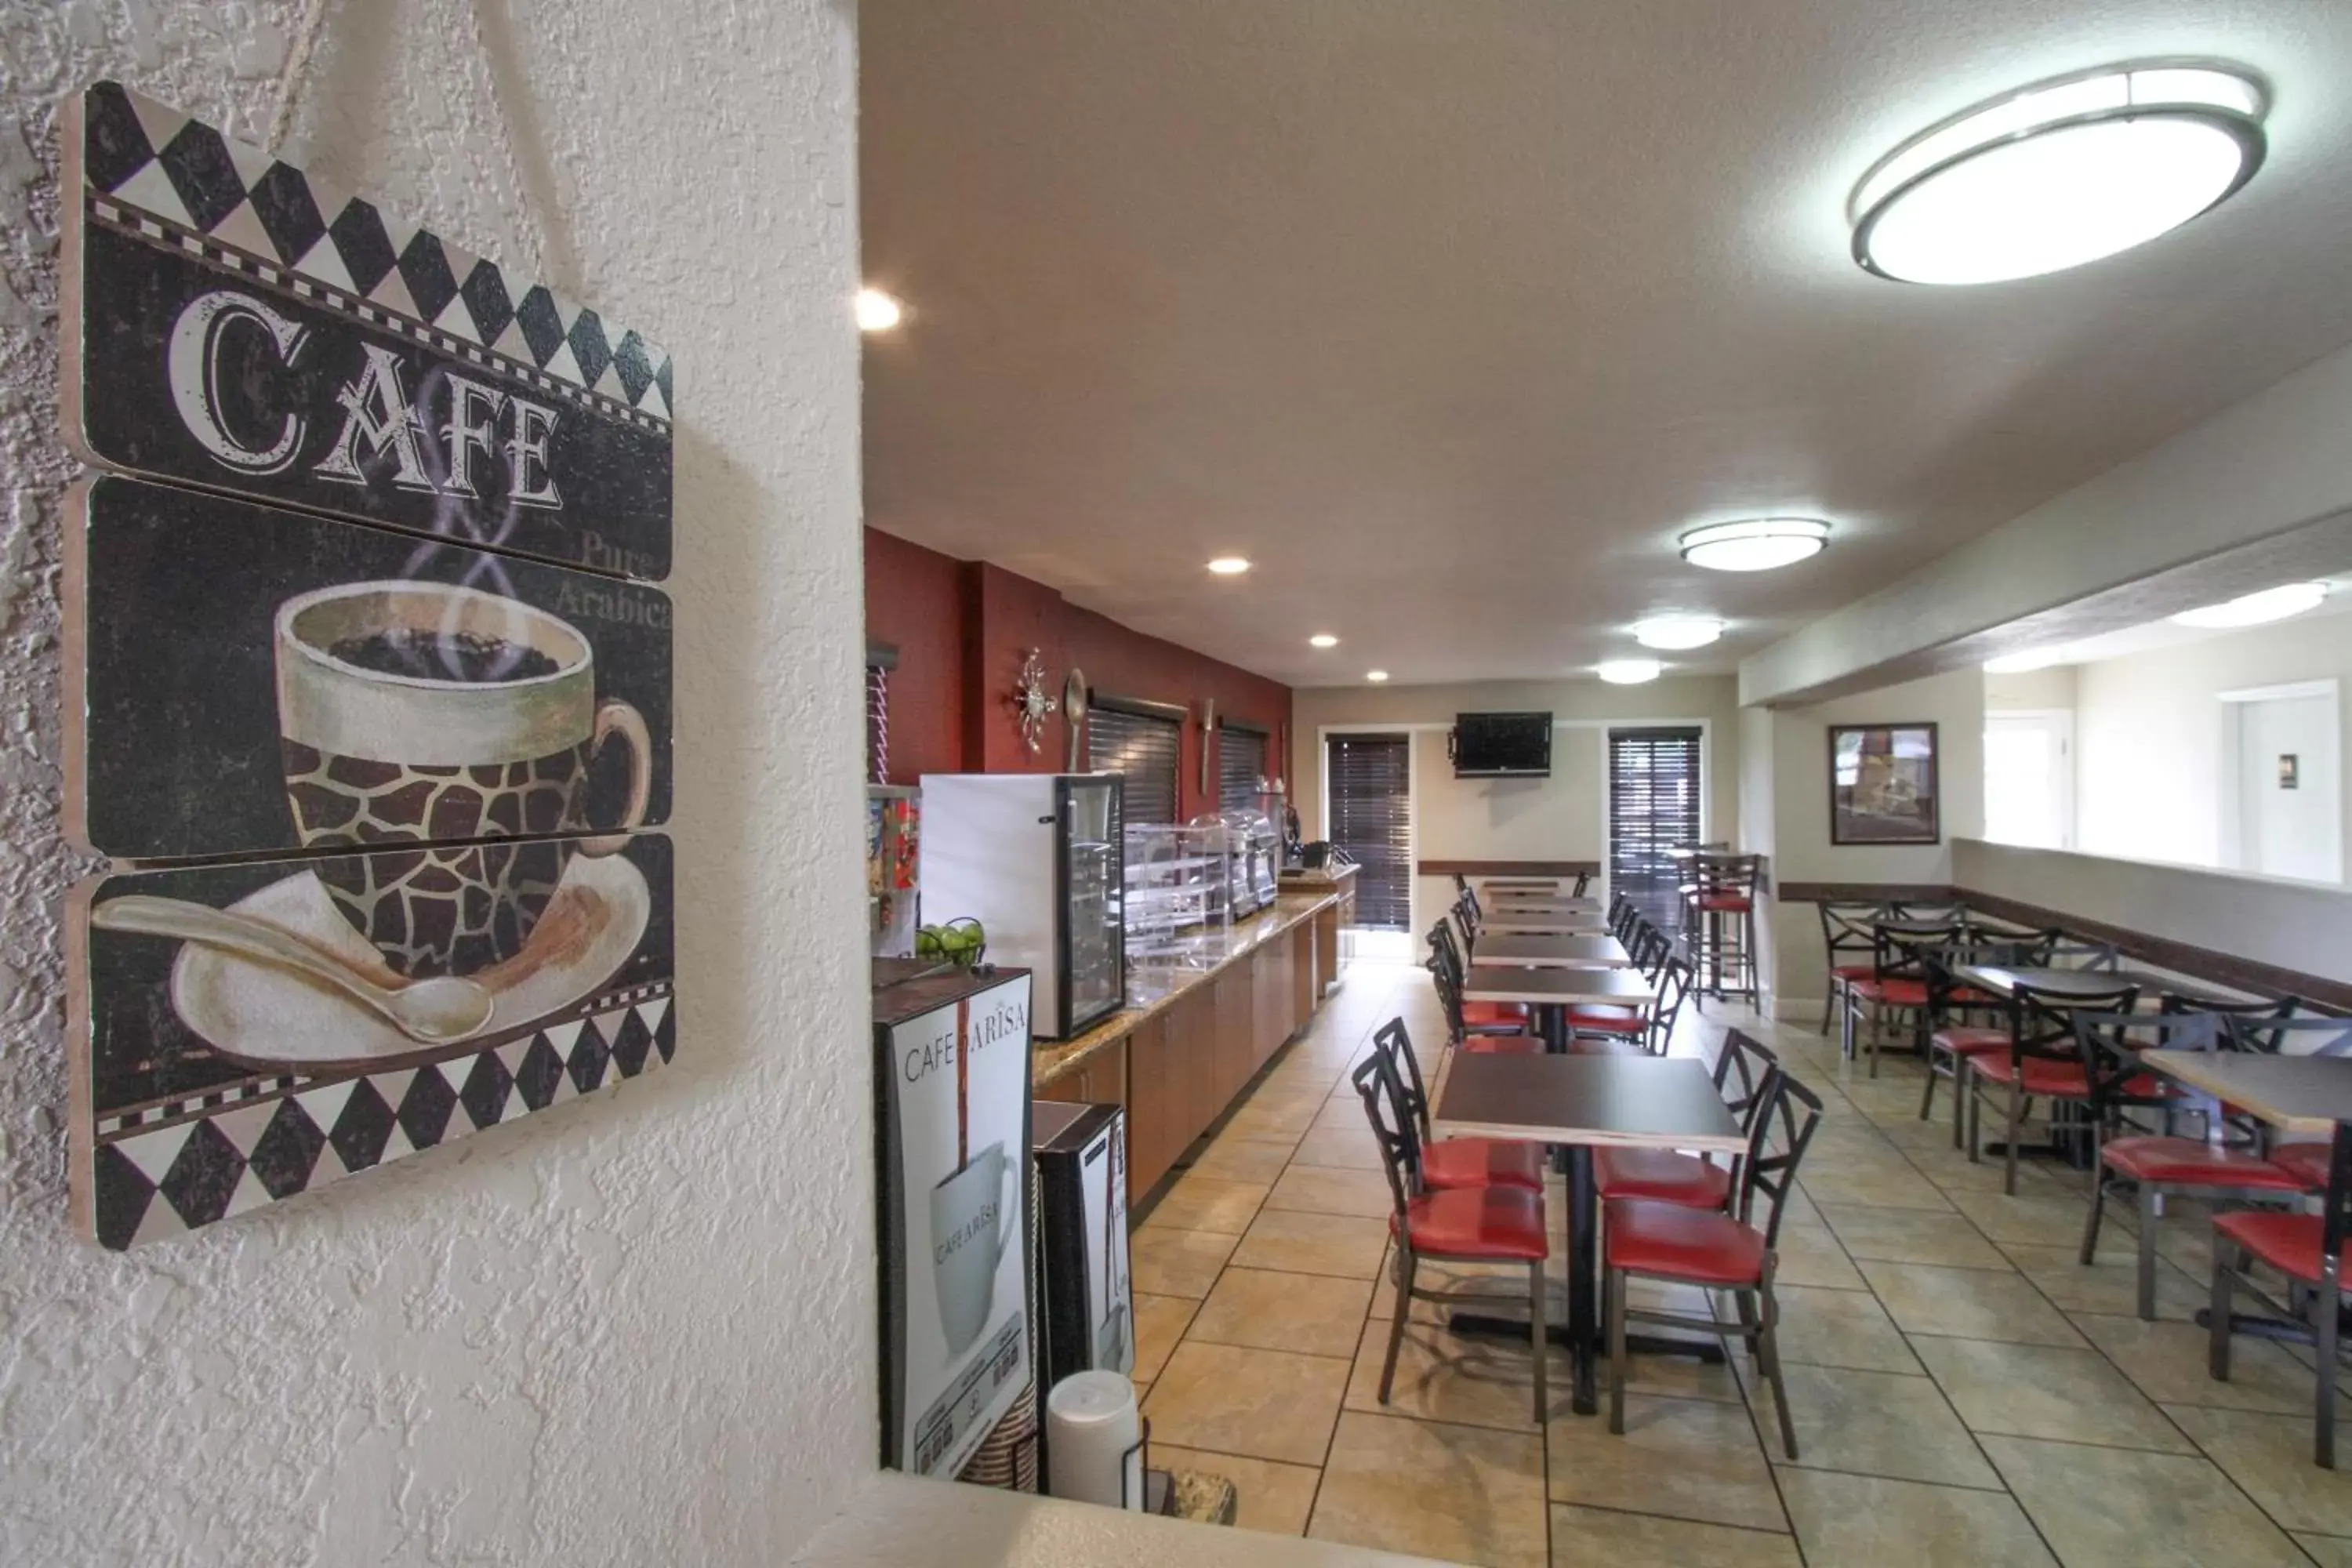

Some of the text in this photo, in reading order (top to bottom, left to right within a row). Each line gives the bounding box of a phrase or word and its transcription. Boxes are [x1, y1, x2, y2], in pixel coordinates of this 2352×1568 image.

[169, 290, 563, 510] CAFE
[581, 528, 655, 575] Pure
[905, 1032, 954, 1082] CAFE
